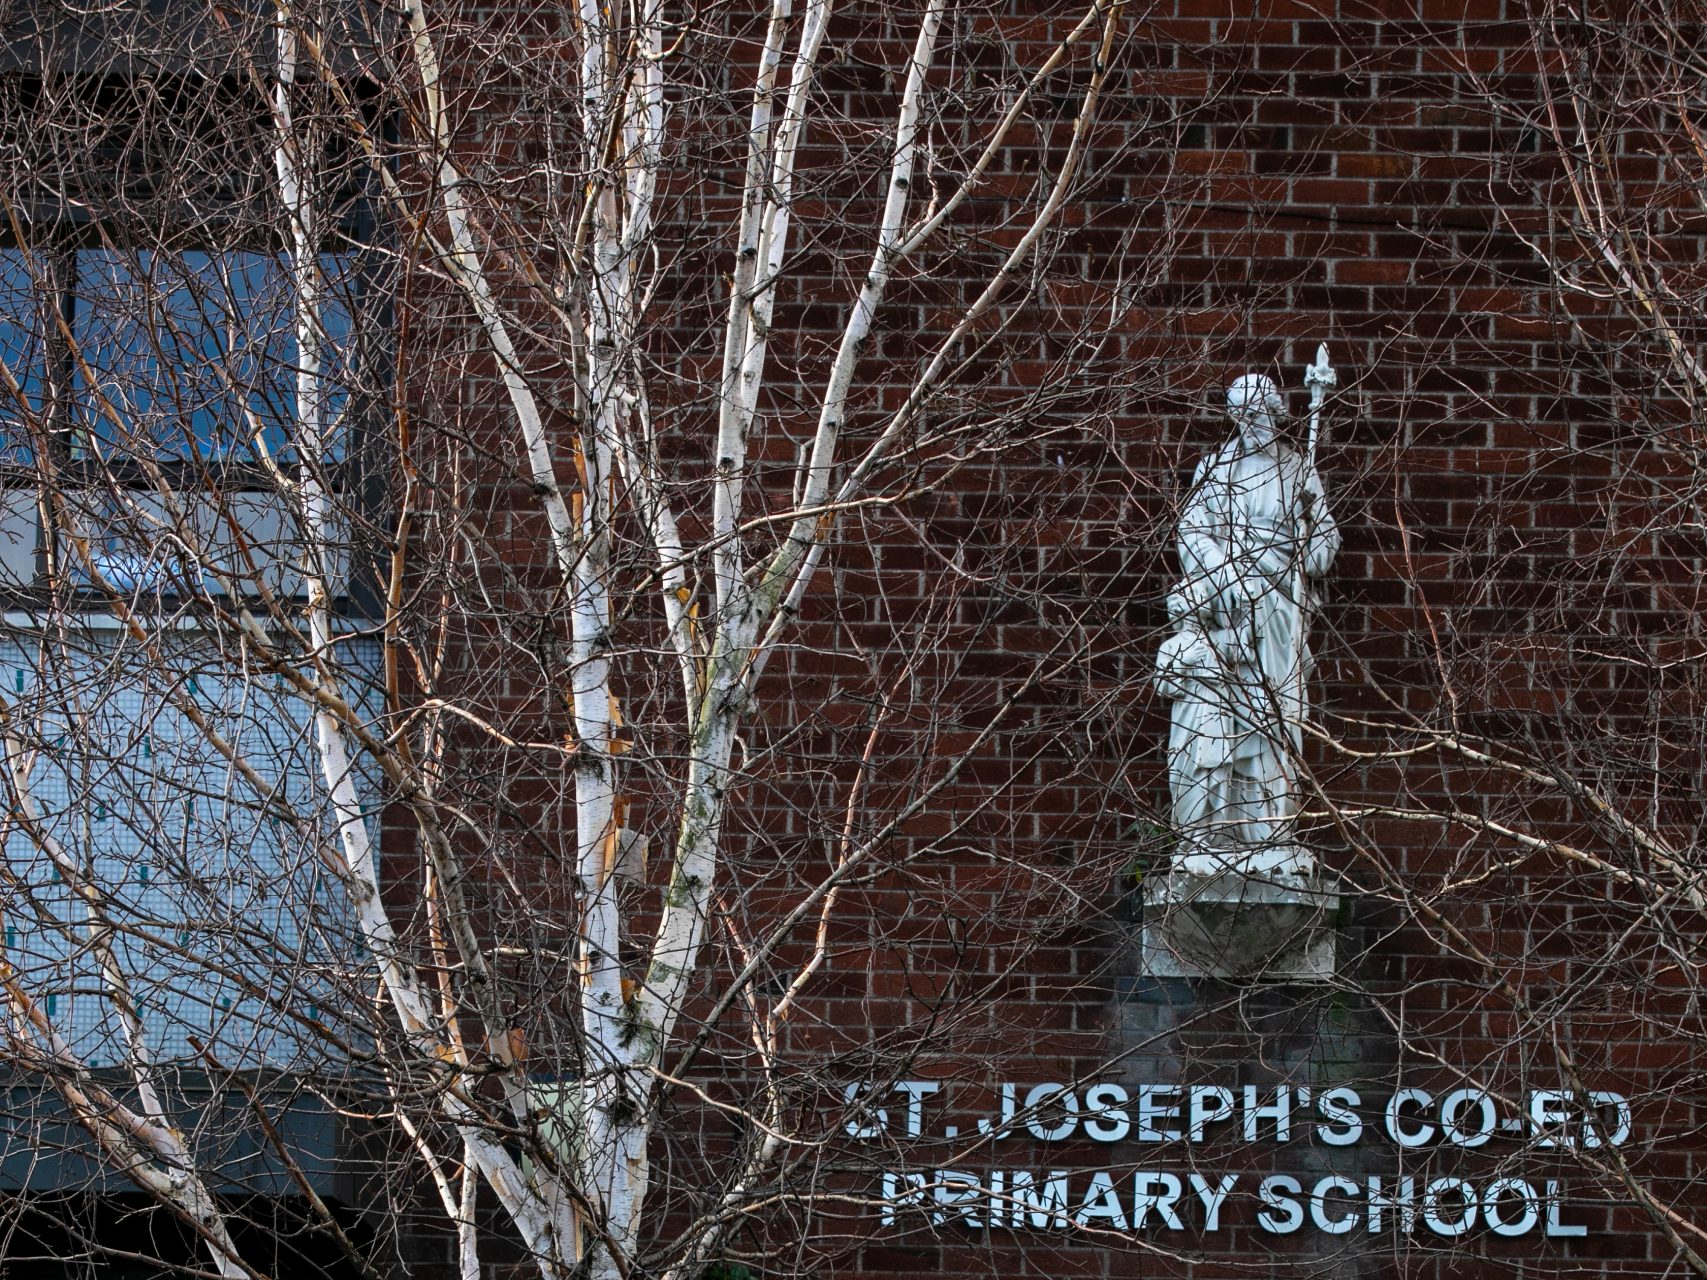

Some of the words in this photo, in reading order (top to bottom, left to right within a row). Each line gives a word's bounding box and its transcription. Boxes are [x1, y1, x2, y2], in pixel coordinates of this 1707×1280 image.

[844, 1081, 957, 1138] ST.
[978, 1083, 1362, 1146] JOSEPH'S
[1386, 1088, 1630, 1148] CO-ED
[882, 1171, 1238, 1231] PRIMARY
[1258, 1175, 1588, 1238] SCHOOL
